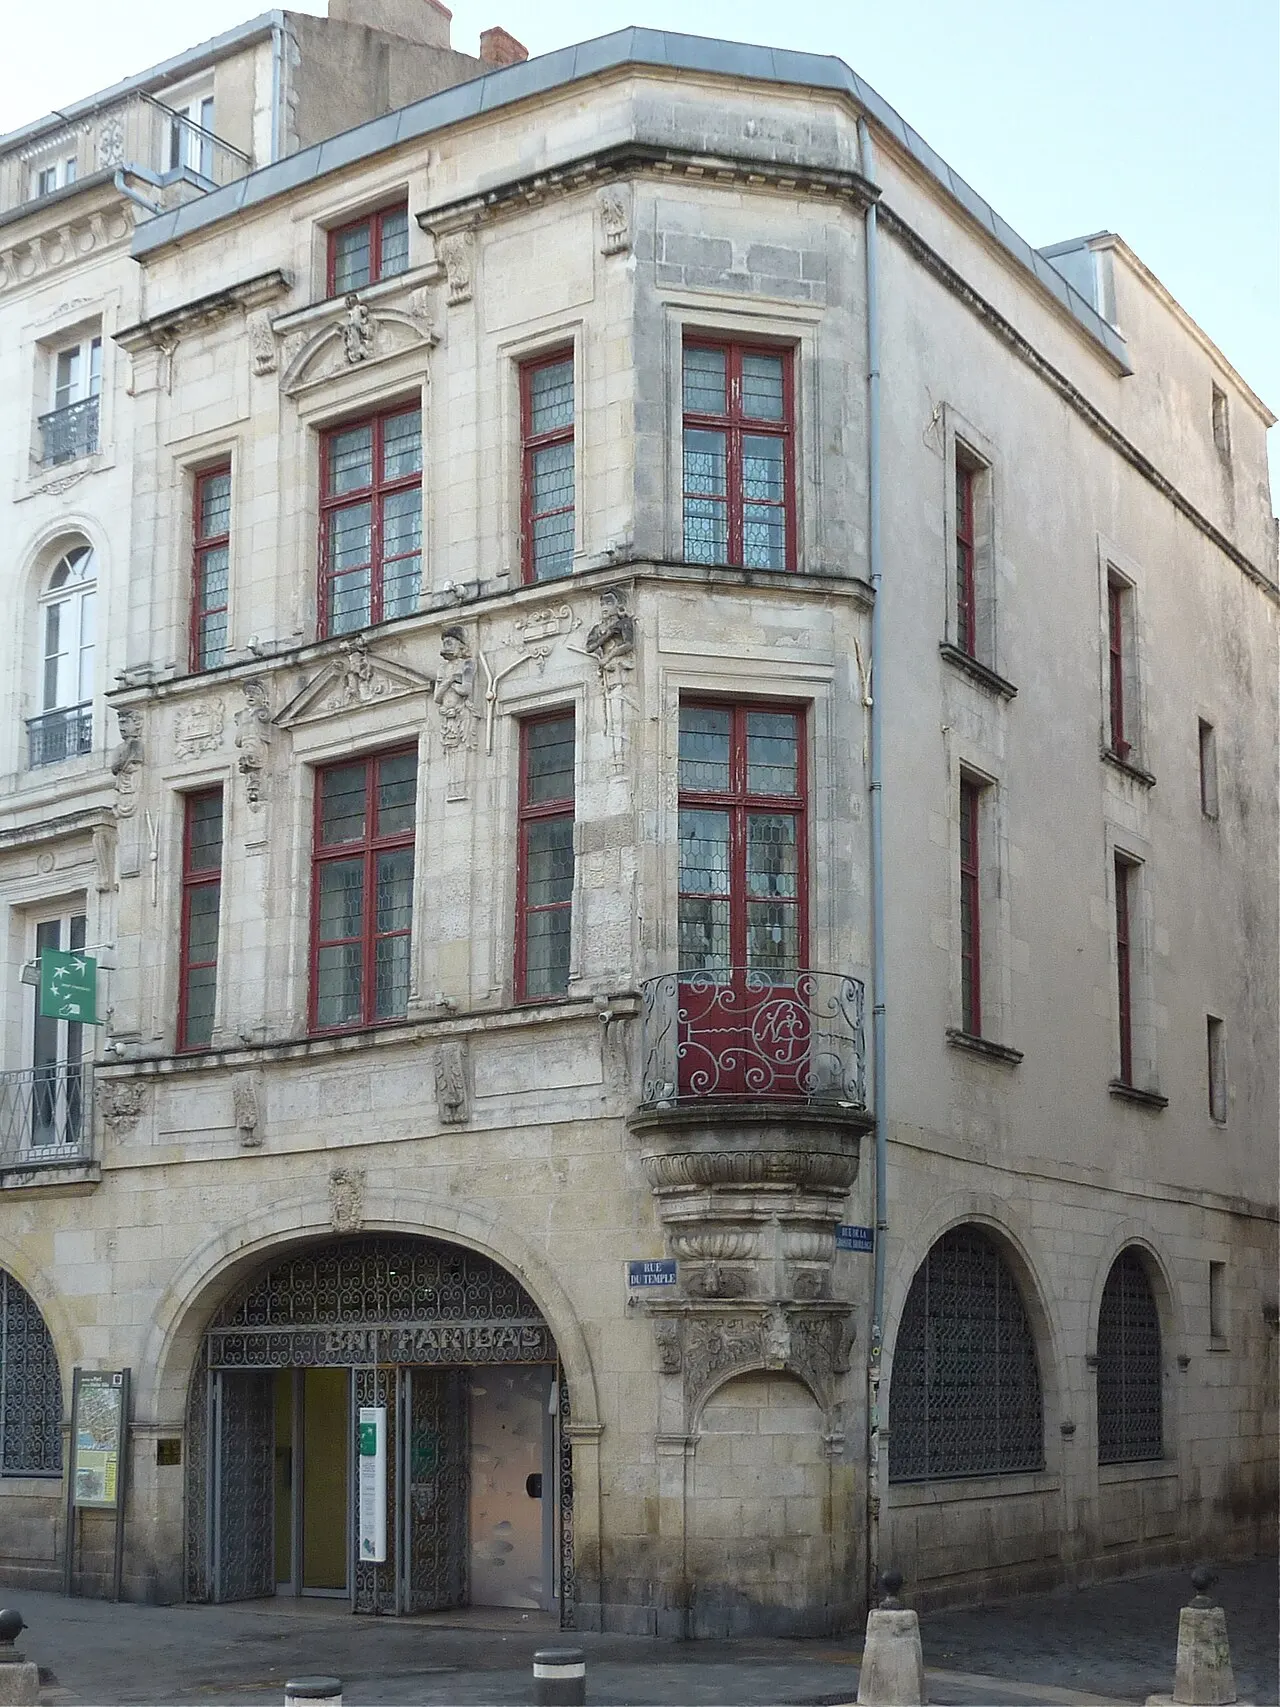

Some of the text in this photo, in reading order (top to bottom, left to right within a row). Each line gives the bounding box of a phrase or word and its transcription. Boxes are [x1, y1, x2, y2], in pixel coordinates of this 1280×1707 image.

[644, 1262, 662, 1272] RUE
[630, 1273, 676, 1284] DU TEMPLE
[398, 1326, 541, 1349] PARIBAS
